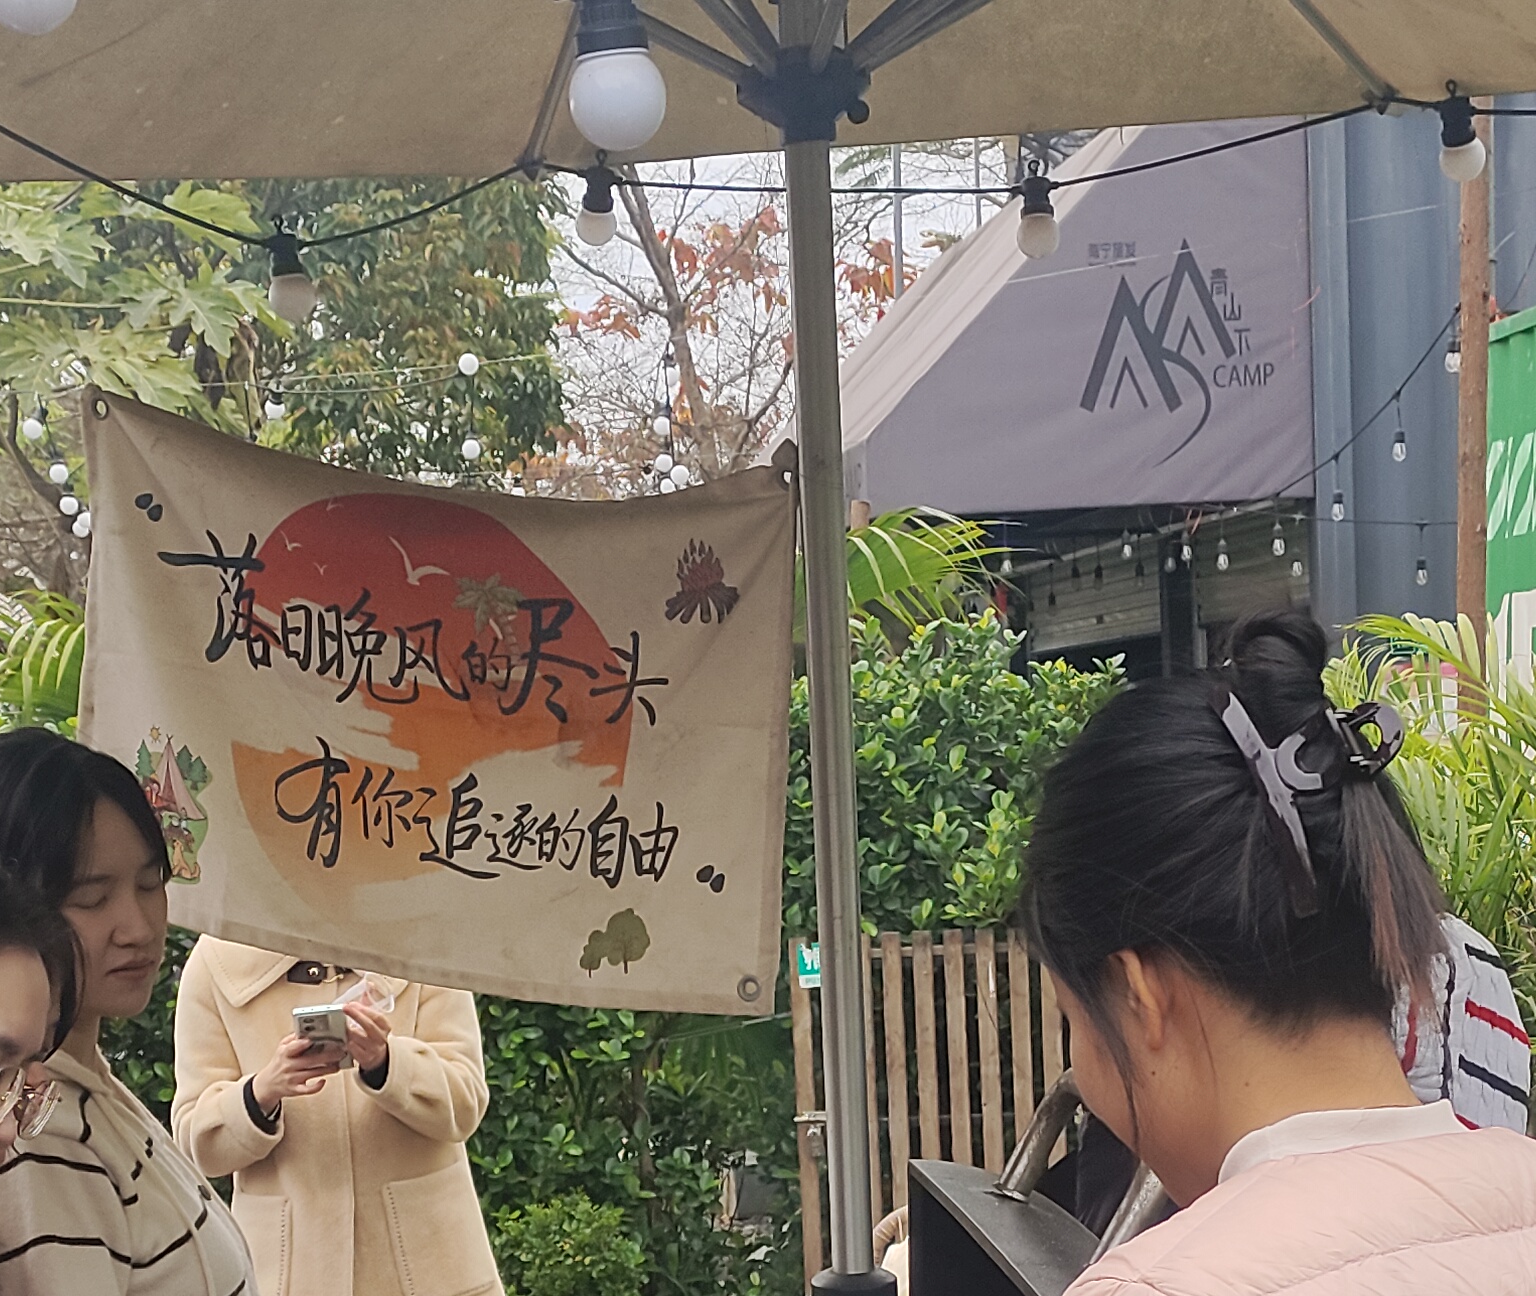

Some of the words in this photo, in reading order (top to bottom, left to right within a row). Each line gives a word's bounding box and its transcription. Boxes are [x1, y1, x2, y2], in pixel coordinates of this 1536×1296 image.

[1212, 361, 1275, 388] CAMP
[157, 528, 670, 727] 落日晚风的尽头
[274, 736, 680, 889] 有你追逐的自由
